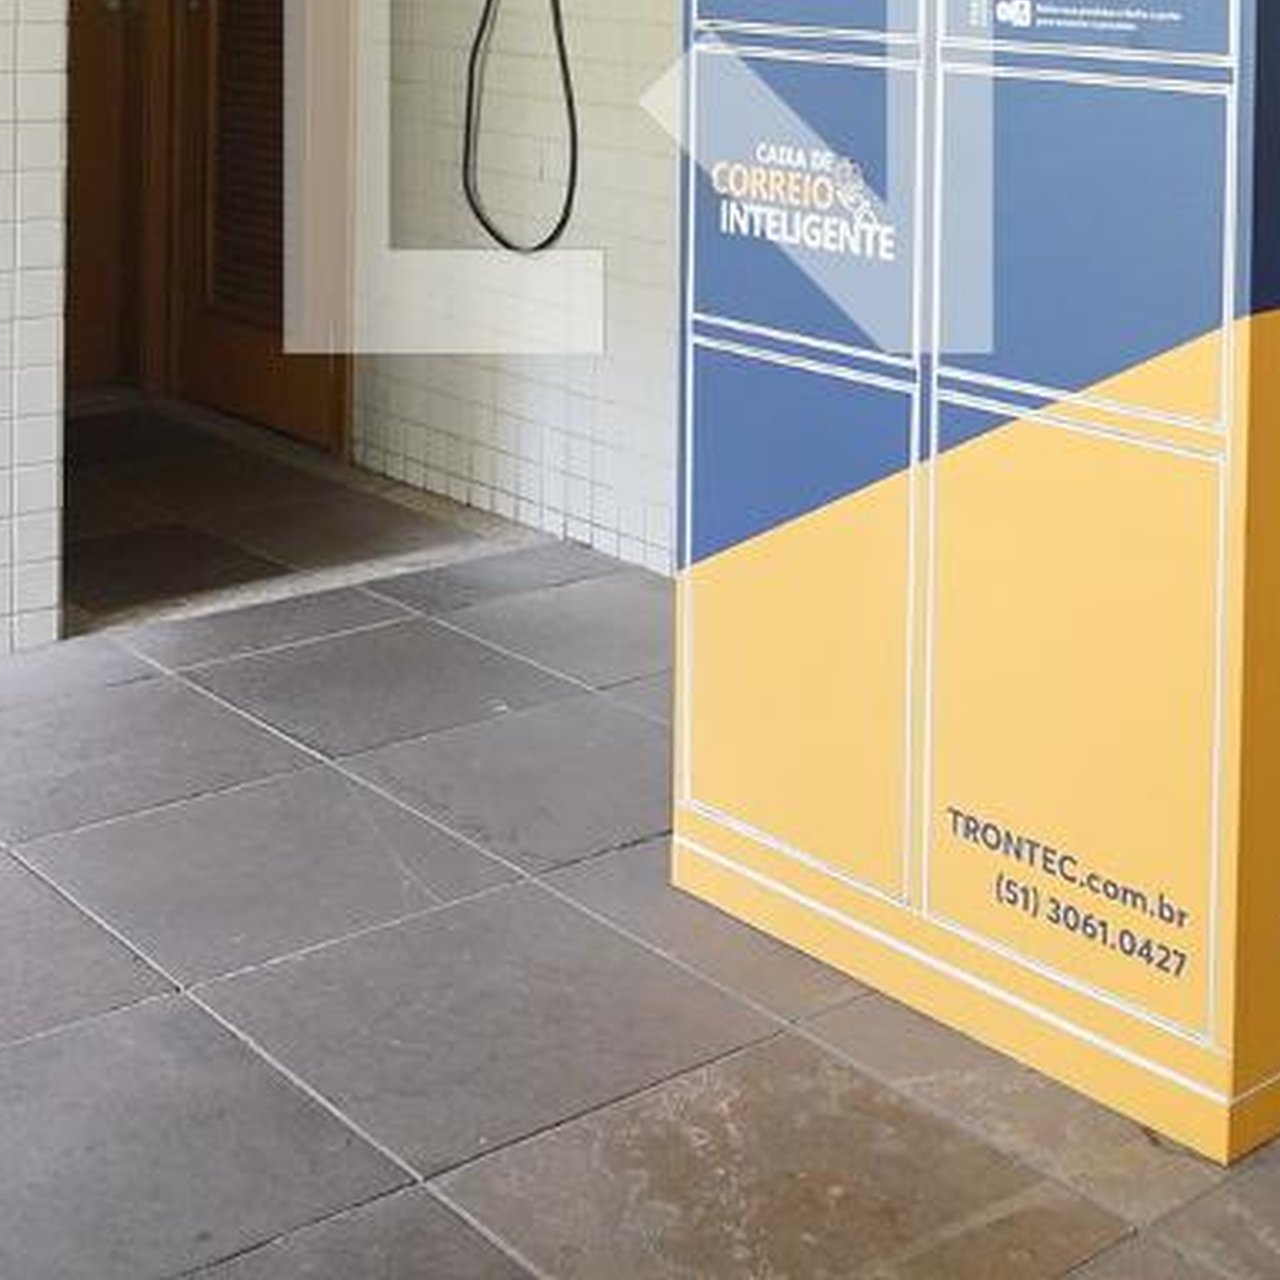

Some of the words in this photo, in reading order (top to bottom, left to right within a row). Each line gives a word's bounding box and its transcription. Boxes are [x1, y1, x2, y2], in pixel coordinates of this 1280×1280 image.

[711, 160, 834, 211] CORREIO
[755, 142, 807, 168] CAIXA
[810, 150, 834, 173] DE
[719, 199, 896, 261] INTELIGENTE
[946, 806, 1190, 928] TRONTEC.com.br
[994, 873, 1041, 920] (51)
[1045, 896, 1188, 976] 3061.0427
